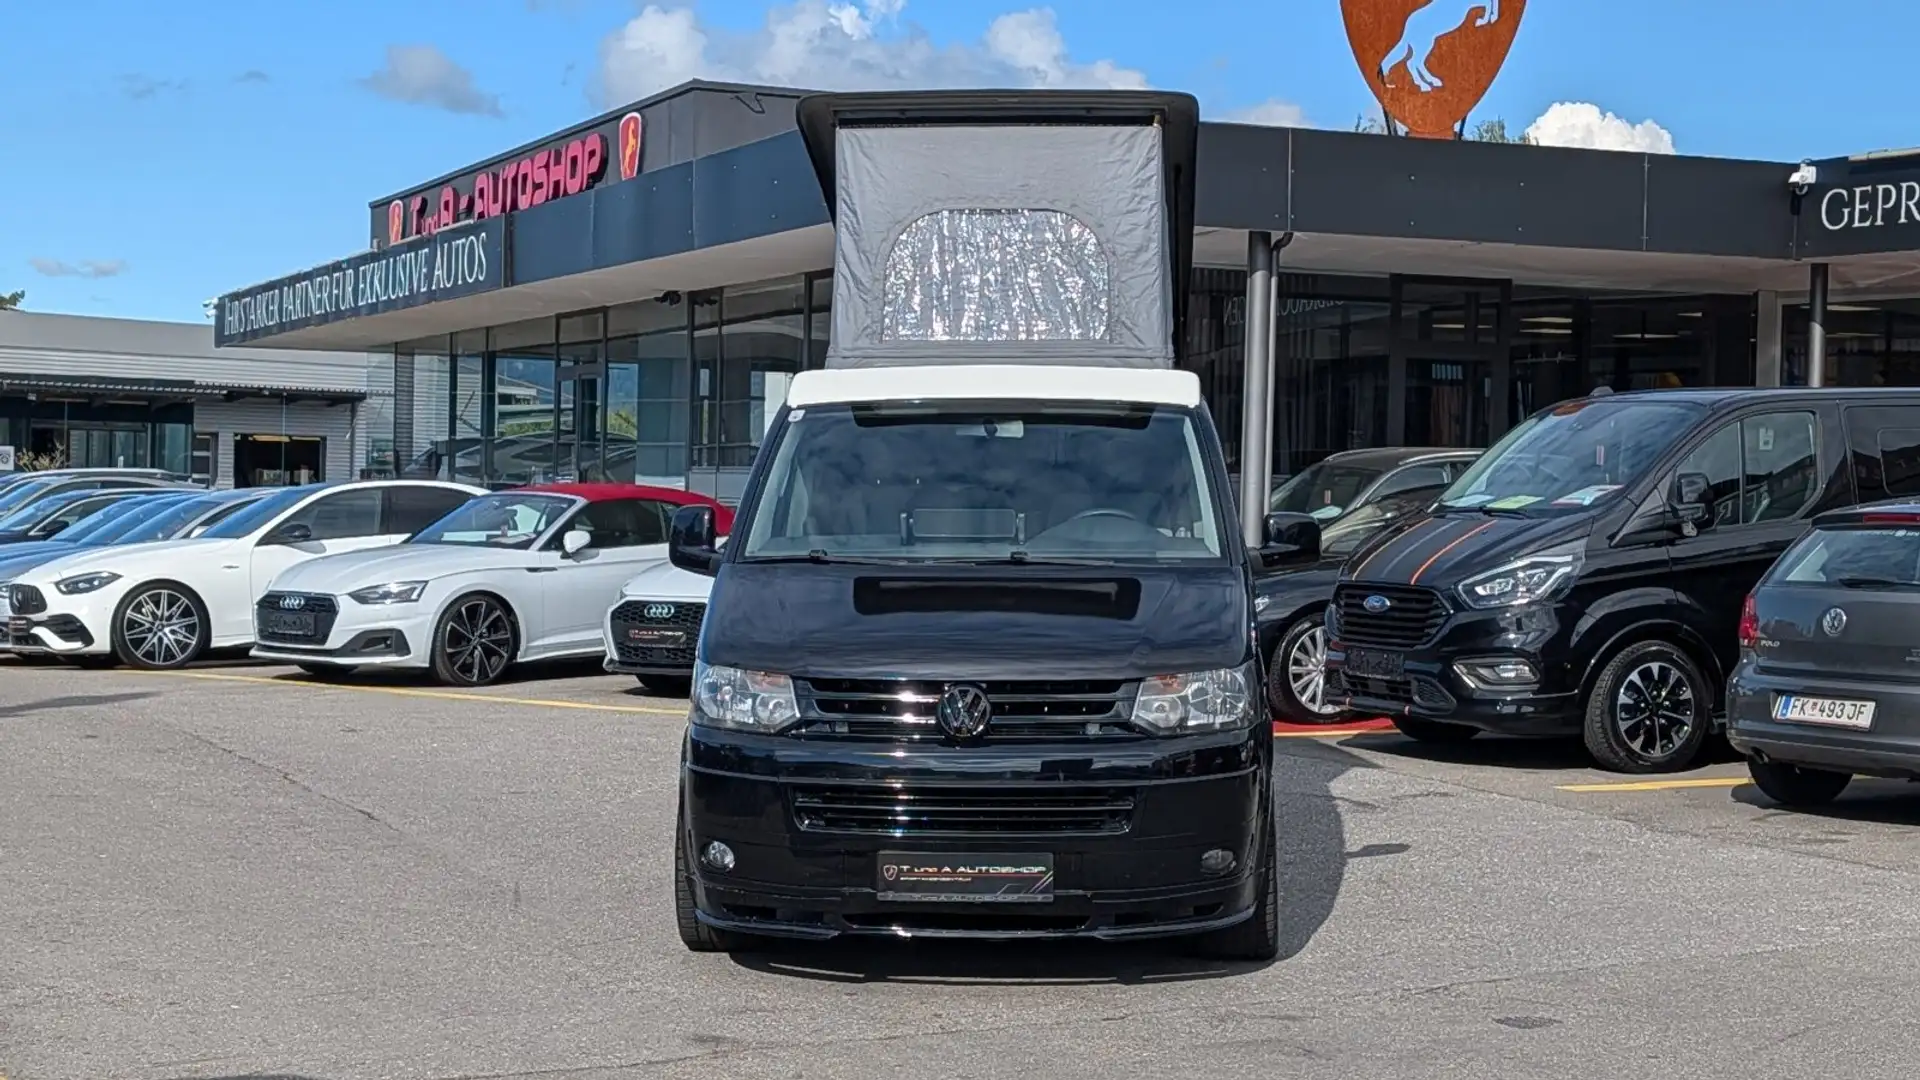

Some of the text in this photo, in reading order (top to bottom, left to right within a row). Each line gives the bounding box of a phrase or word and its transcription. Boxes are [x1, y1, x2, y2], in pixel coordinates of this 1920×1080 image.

[440, 184, 454, 227] A
[474, 133, 602, 221] AUTOSHOP
[1821, 181, 1920, 230] GEPR
[240, 289, 280, 332] STARKER
[282, 275, 331, 322] PARTNER
[332, 262, 355, 311] FÜR
[358, 248, 430, 306] EXKLUSIVE
[431, 231, 487, 290] AUTOS
[1791, 698, 1809, 716] FK
[899, 865, 911, 873] T
[940, 865, 953, 873] A
[956, 865, 1047, 874] AUTOSHOP
